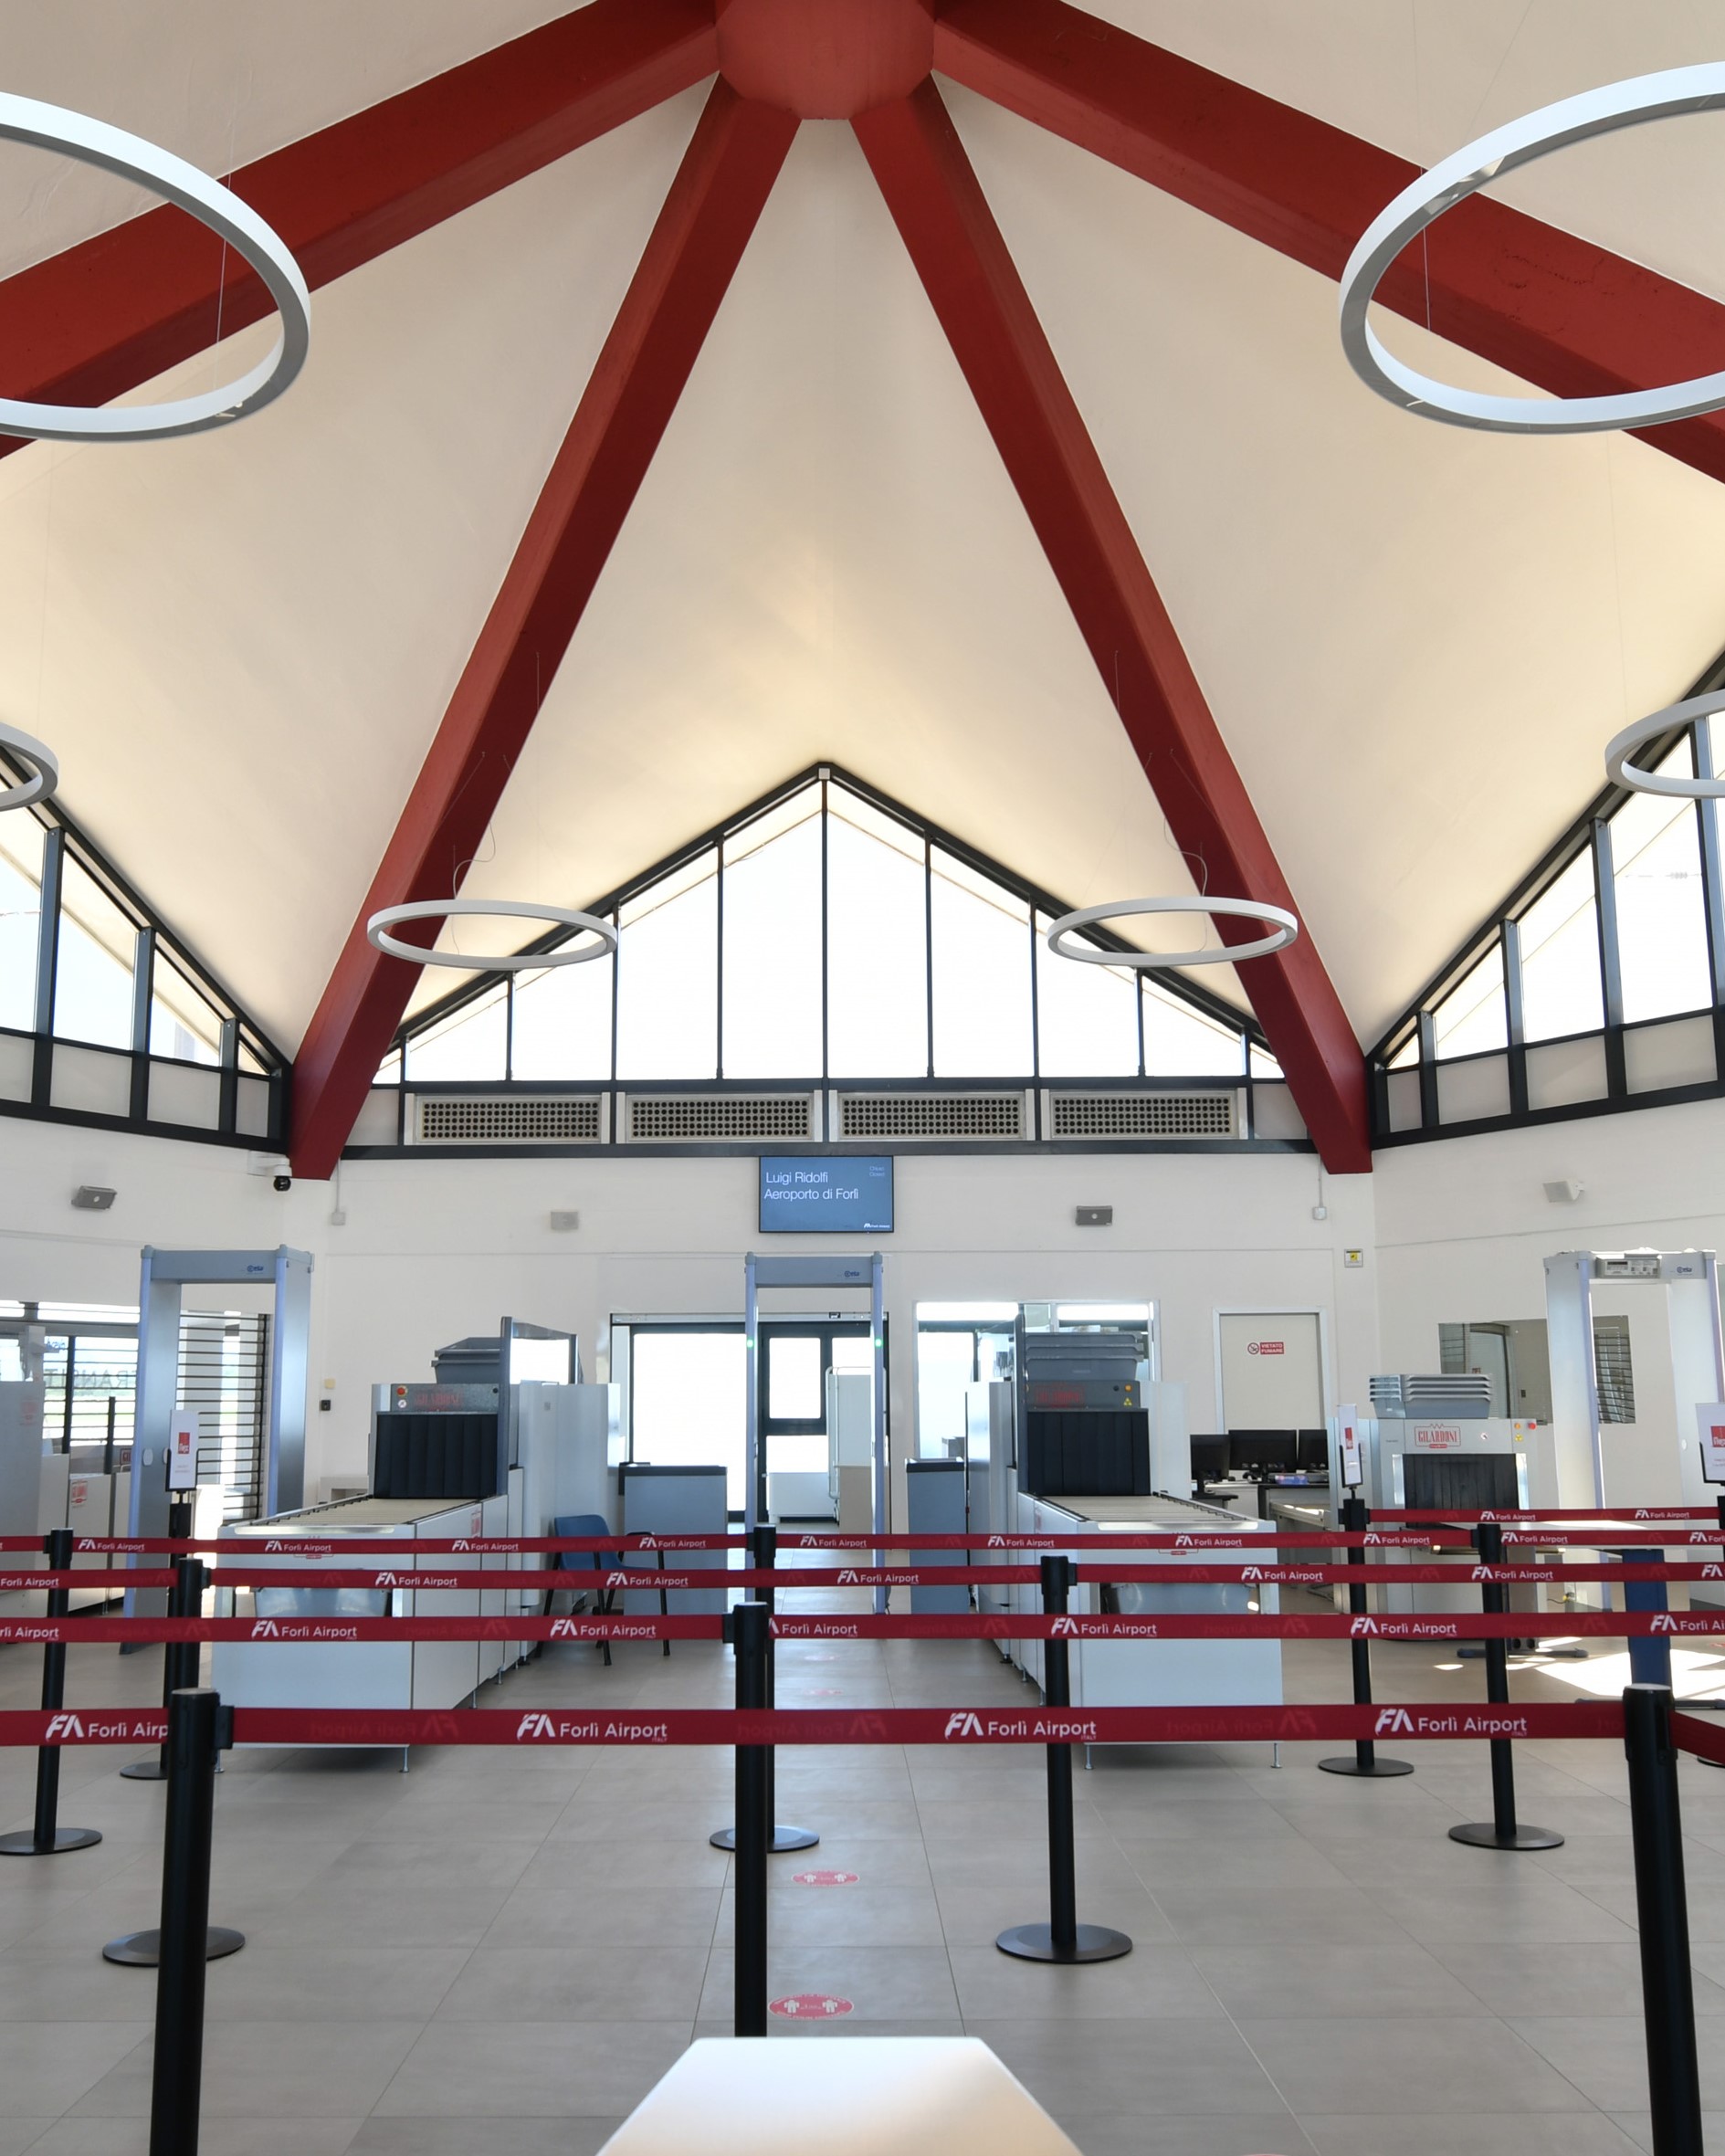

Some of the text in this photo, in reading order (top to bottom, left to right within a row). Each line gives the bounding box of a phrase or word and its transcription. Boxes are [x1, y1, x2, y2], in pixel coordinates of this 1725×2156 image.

[766, 1172, 828, 1185] Luigi Ridolfi
[764, 1188, 858, 1202] Aeroporto di Forlì
[1418, 1430, 1457, 1443] GILARDONI
[1513, 1513, 1536, 1522] Airport
[1667, 1511, 1689, 1520] Airport
[658, 1540, 677, 1548] Forlì
[678, 1540, 706, 1549] Airport
[839, 1539, 867, 1548] Airport
[1006, 1539, 1024, 1547] Forlì
[1026, 1539, 1054, 1548] Airport
[1194, 1538, 1212, 1546] Forlì
[1215, 1538, 1242, 1548] Airport
[1382, 1537, 1400, 1545] Forlì
[1403, 1536, 1430, 1546] Airport
[1520, 1535, 1538, 1543] Forlì
[1541, 1535, 1568, 1544] Airport
[98, 1542, 115, 1551] Forlì
[118, 1542, 144, 1551] Airport
[284, 1543, 301, 1551] Forlì
[304, 1543, 331, 1552] Airport
[490, 1542, 519, 1551] Airport
[860, 1573, 882, 1583] Forlì
[885, 1573, 919, 1584] Airport
[1265, 1571, 1287, 1580] Forlì
[1289, 1571, 1323, 1582] Airport
[1495, 1570, 1517, 1580] Forlì
[1520, 1570, 1553, 1581] Airport
[0, 1578, 59, 1587] Forlì Airport
[398, 1577, 420, 1586] Forlì
[424, 1577, 458, 1587] Airport
[630, 1576, 651, 1585] Forlì
[655, 1576, 689, 1587] Airport
[580, 1625, 608, 1635] Forlì
[612, 1625, 657, 1637] Airport
[783, 1624, 810, 1634] Forlì
[814, 1624, 858, 1636] Airport
[1081, 1624, 1109, 1635] Forlì
[1112, 1624, 1157, 1636] Airport
[1381, 1623, 1408, 1634] Forlì
[1412, 1623, 1457, 1636] Airport
[1680, 1621, 1708, 1631] Forlì
[0, 1626, 59, 1639] rlì Airport
[281, 1625, 309, 1636] Forlì
[313, 1625, 357, 1639] Airport
[89, 1722, 128, 1738] Forlì
[132, 1722, 168, 1740] Airp
[988, 1720, 1027, 1736] Forlì
[1033, 1720, 1096, 1738] Airport
[1418, 1717, 1457, 1731] Forlì
[1463, 1717, 1527, 1734] Airport
[560, 1722, 599, 1738] Forlì
[605, 1722, 668, 1741] Airport
